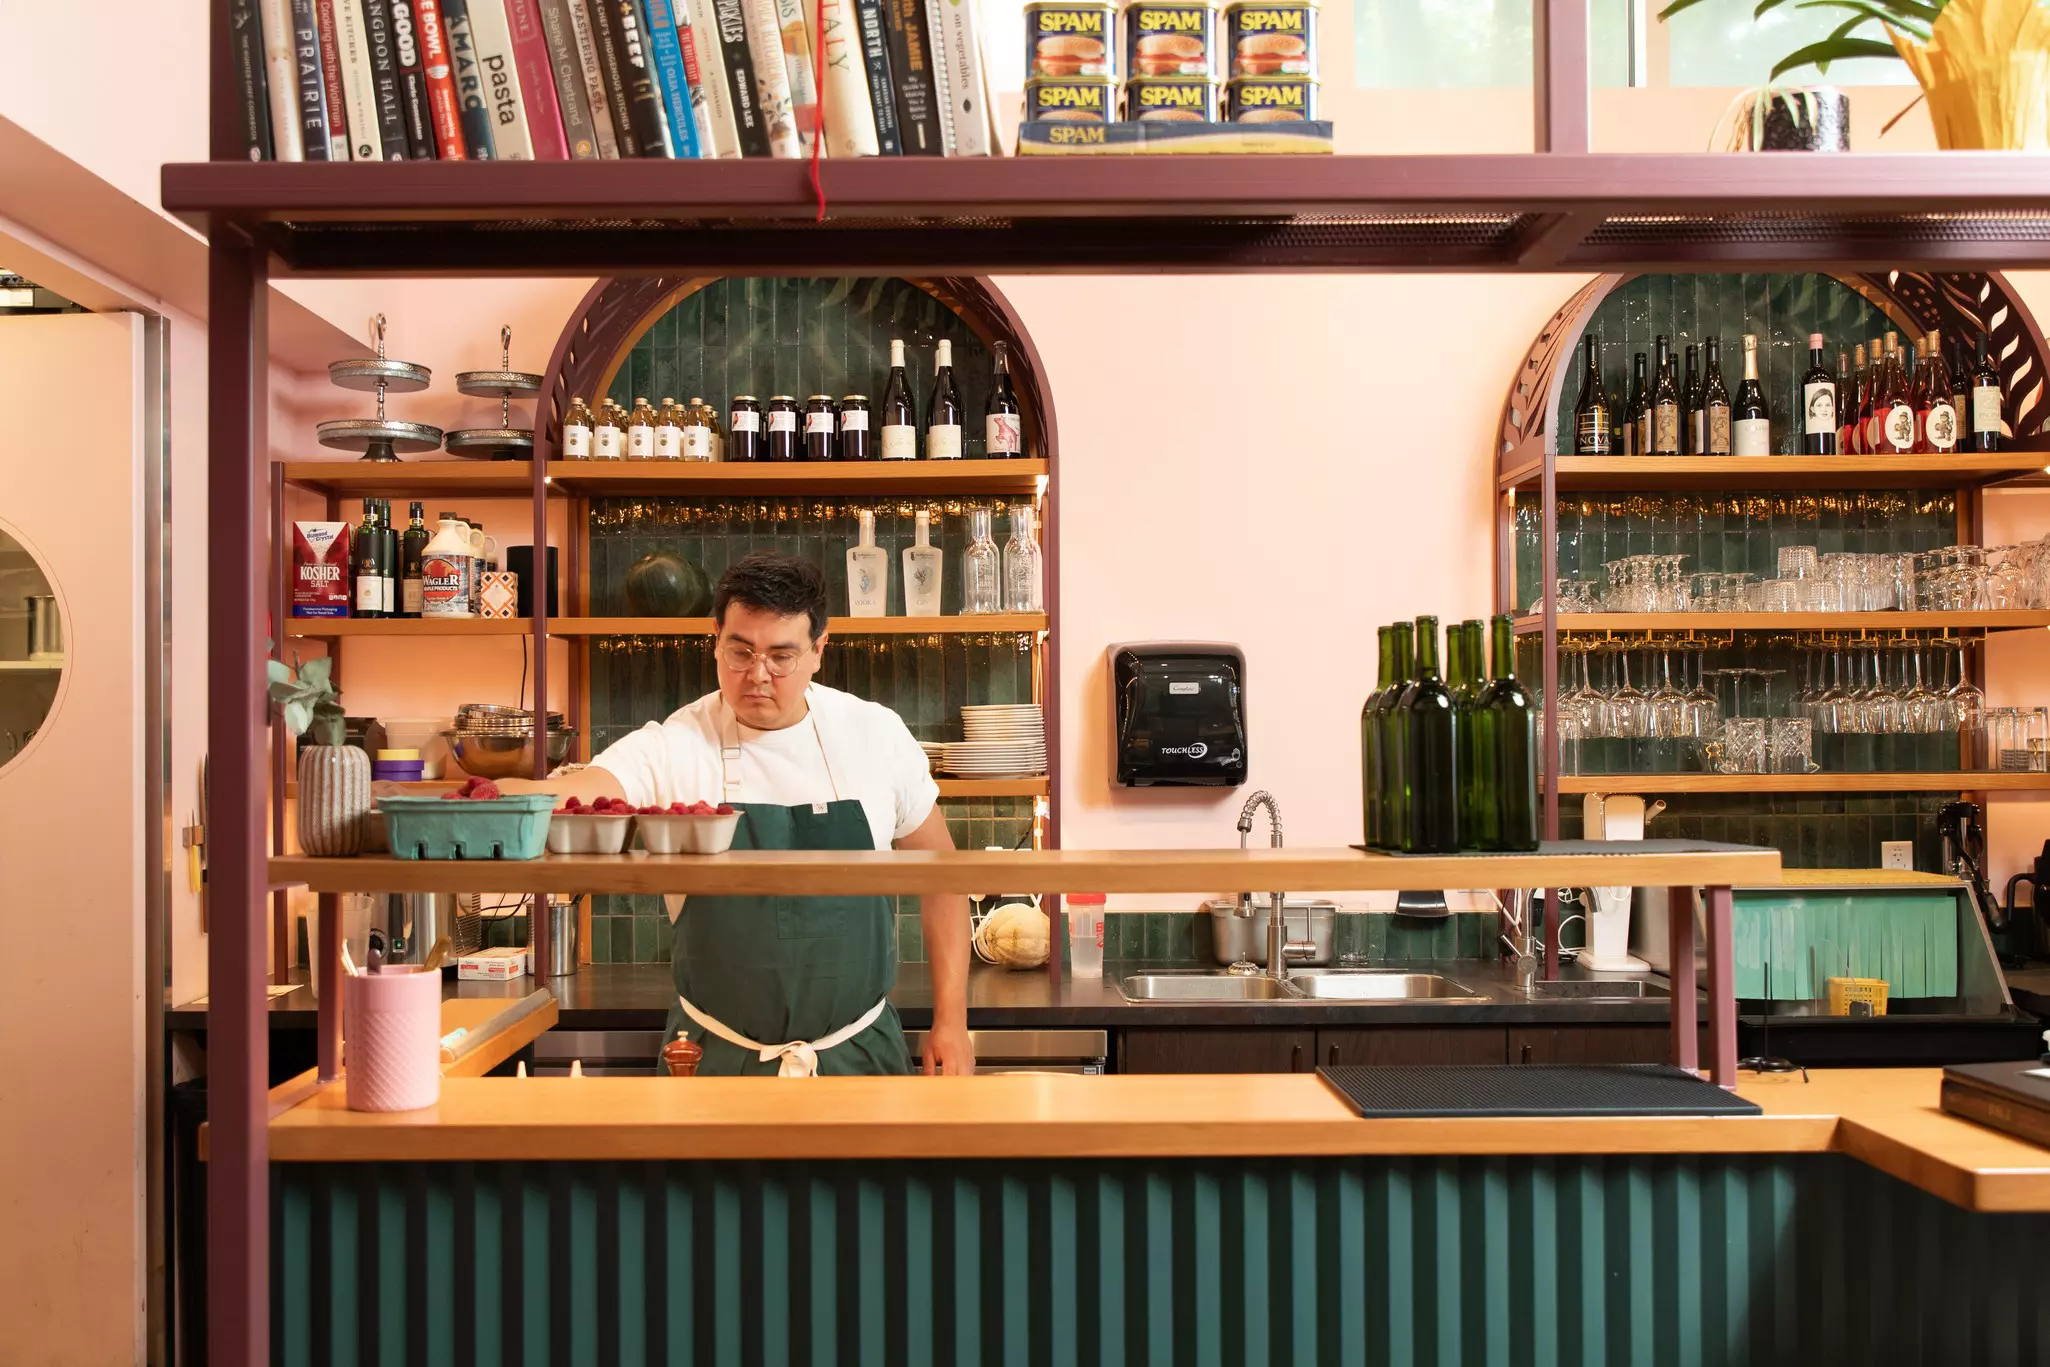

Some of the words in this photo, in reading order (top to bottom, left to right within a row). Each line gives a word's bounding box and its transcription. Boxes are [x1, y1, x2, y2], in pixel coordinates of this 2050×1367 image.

[320, 2, 332, 41] Cooking
[422, 12, 442, 59] BOWL
[549, 8, 563, 45] Shane
[718, 0, 744, 43] PICKLES
[863, 8, 883, 58] NORTH
[954, 14, 962, 28] on
[1039, 12, 1102, 32] SPAM
[1140, 10, 1201, 30] SPAM
[1240, 10, 1302, 30] SPAM
[325, 42, 336, 62] with
[558, 47, 568, 64] M.
[574, 4, 596, 72] MASTERING
[589, 76, 604, 114] PASTA
[622, 15, 644, 68] BEEF
[906, 22, 924, 71] JAMIE
[956, 31, 971, 90] vegetables
[297, 28, 322, 129] PRAIRIE
[327, 66, 336, 81] the
[482, 55, 516, 126] pasta
[604, 38, 622, 92] INDIGENOUS
[616, 93, 630, 130] KITCHEN
[328, 82, 342, 128] Wolfman
[380, 78, 397, 125] HALL
[561, 66, 582, 126] Chartrand
[735, 68, 749, 108] EDWARD
[744, 108, 754, 128] LEE
[1038, 86, 1101, 107] SPAM
[1140, 86, 1202, 106] SPAM
[1240, 86, 1302, 106] SPAM
[1049, 126, 1104, 144] SPAM
[300, 566, 340, 580] KOSHER
